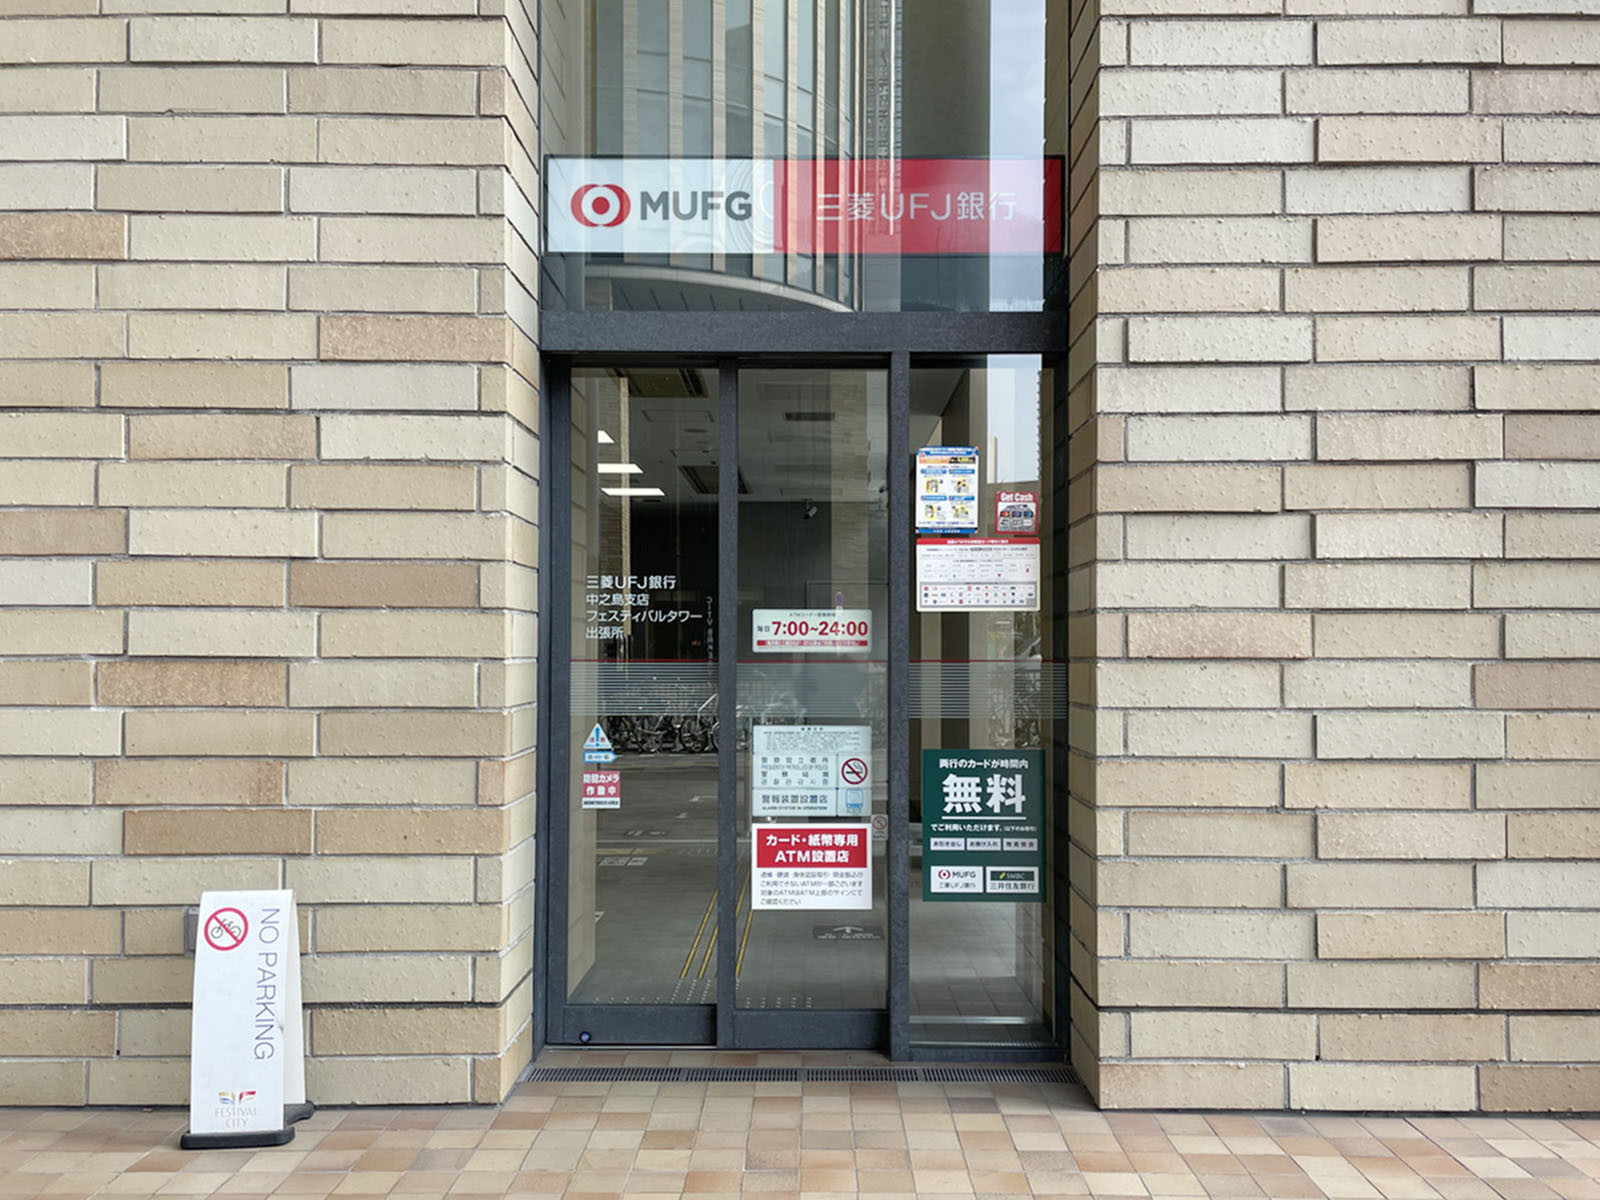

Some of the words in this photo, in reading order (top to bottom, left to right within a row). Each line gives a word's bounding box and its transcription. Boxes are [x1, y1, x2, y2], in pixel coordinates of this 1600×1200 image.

[640, 190, 752, 221] MUFG
[816, 191, 1017, 222] 三菱UFJ銀行
[1000, 493, 1013, 501] Get
[1015, 493, 1034, 501] Cash
[586, 575, 677, 589] 三菱UFJ銀行
[586, 594, 650, 606] 中之島支店
[586, 610, 703, 622] フェスティバルタワー
[586, 626, 624, 639] 出張所
[939, 758, 1029, 769] 両行のカードが時間内
[942, 773, 1026, 813] 無料
[766, 834, 858, 846] カード・紙幣専用
[775, 850, 850, 863] ATM設置店
[952, 871, 976, 879] MUFG
[1006, 872, 1025, 880] SMBC
[990, 882, 1035, 890] 三井住友銀行
[258, 908, 281, 944] NO
[254, 952, 278, 1060] PARKING
[214, 1106, 258, 1117] FESTIVAL
[225, 1118, 249, 1128] CITY
